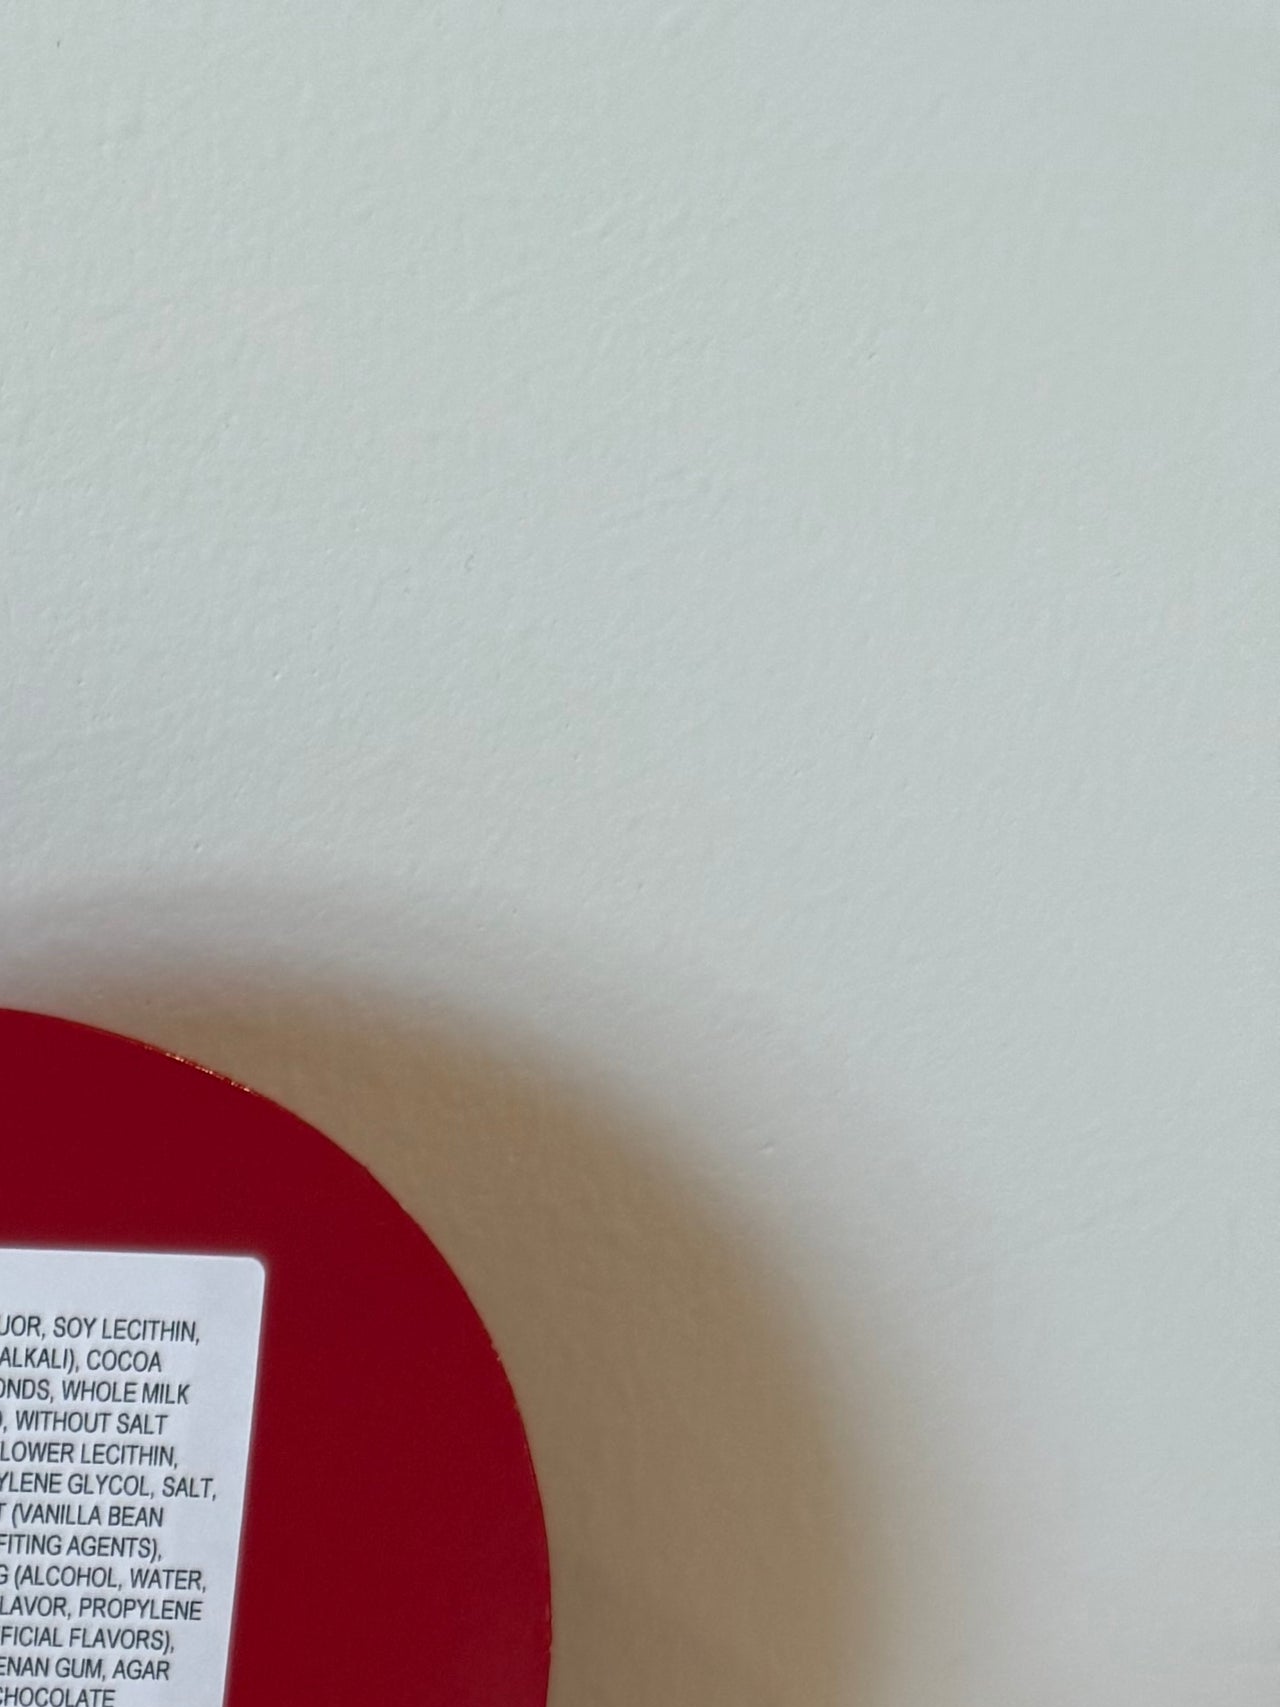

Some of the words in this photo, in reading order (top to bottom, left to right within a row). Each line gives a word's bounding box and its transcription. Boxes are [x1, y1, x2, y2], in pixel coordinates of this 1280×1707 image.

[52, 1315, 98, 1339] SOY
[101, 1317, 200, 1346] LECITHIN,
[86, 1348, 162, 1373] COCOA
